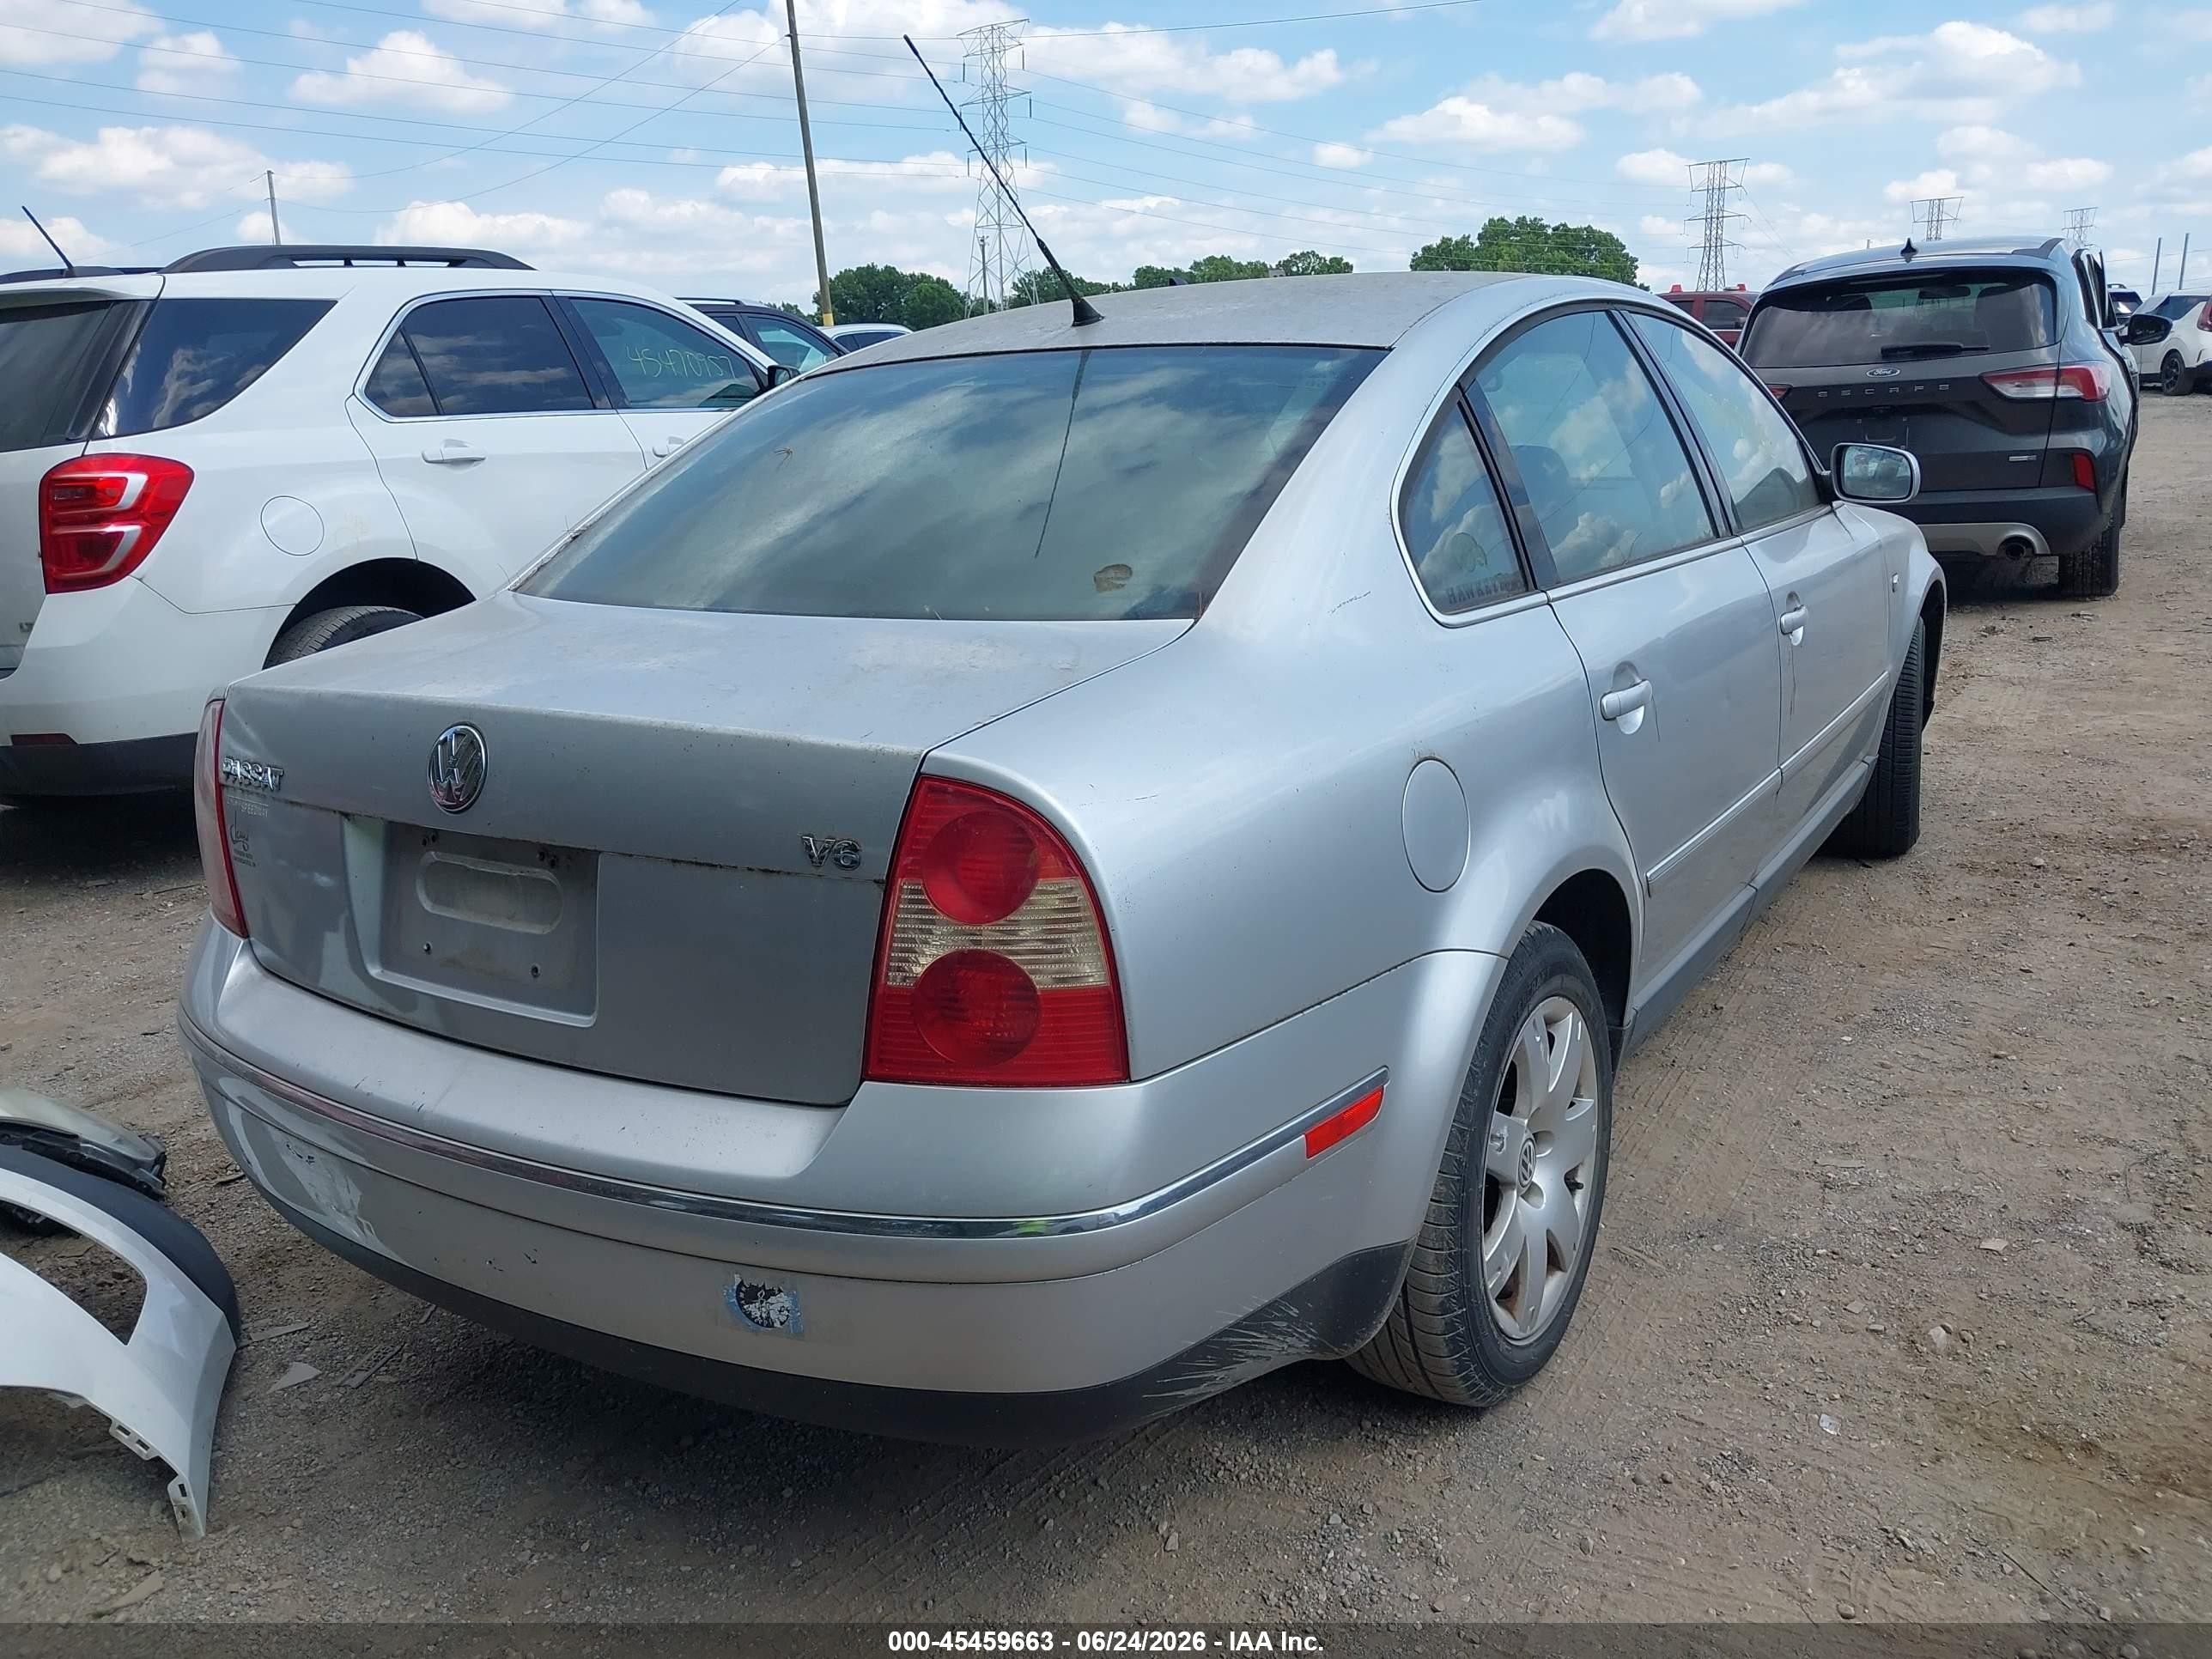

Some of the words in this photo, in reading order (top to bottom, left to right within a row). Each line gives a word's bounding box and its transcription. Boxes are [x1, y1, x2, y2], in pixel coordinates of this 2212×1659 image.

[626, 345, 736, 380] 45470957
[1816, 383, 1950, 398] ESCAPE
[222, 757, 284, 791] PASSAT
[801, 834, 862, 871] V6
